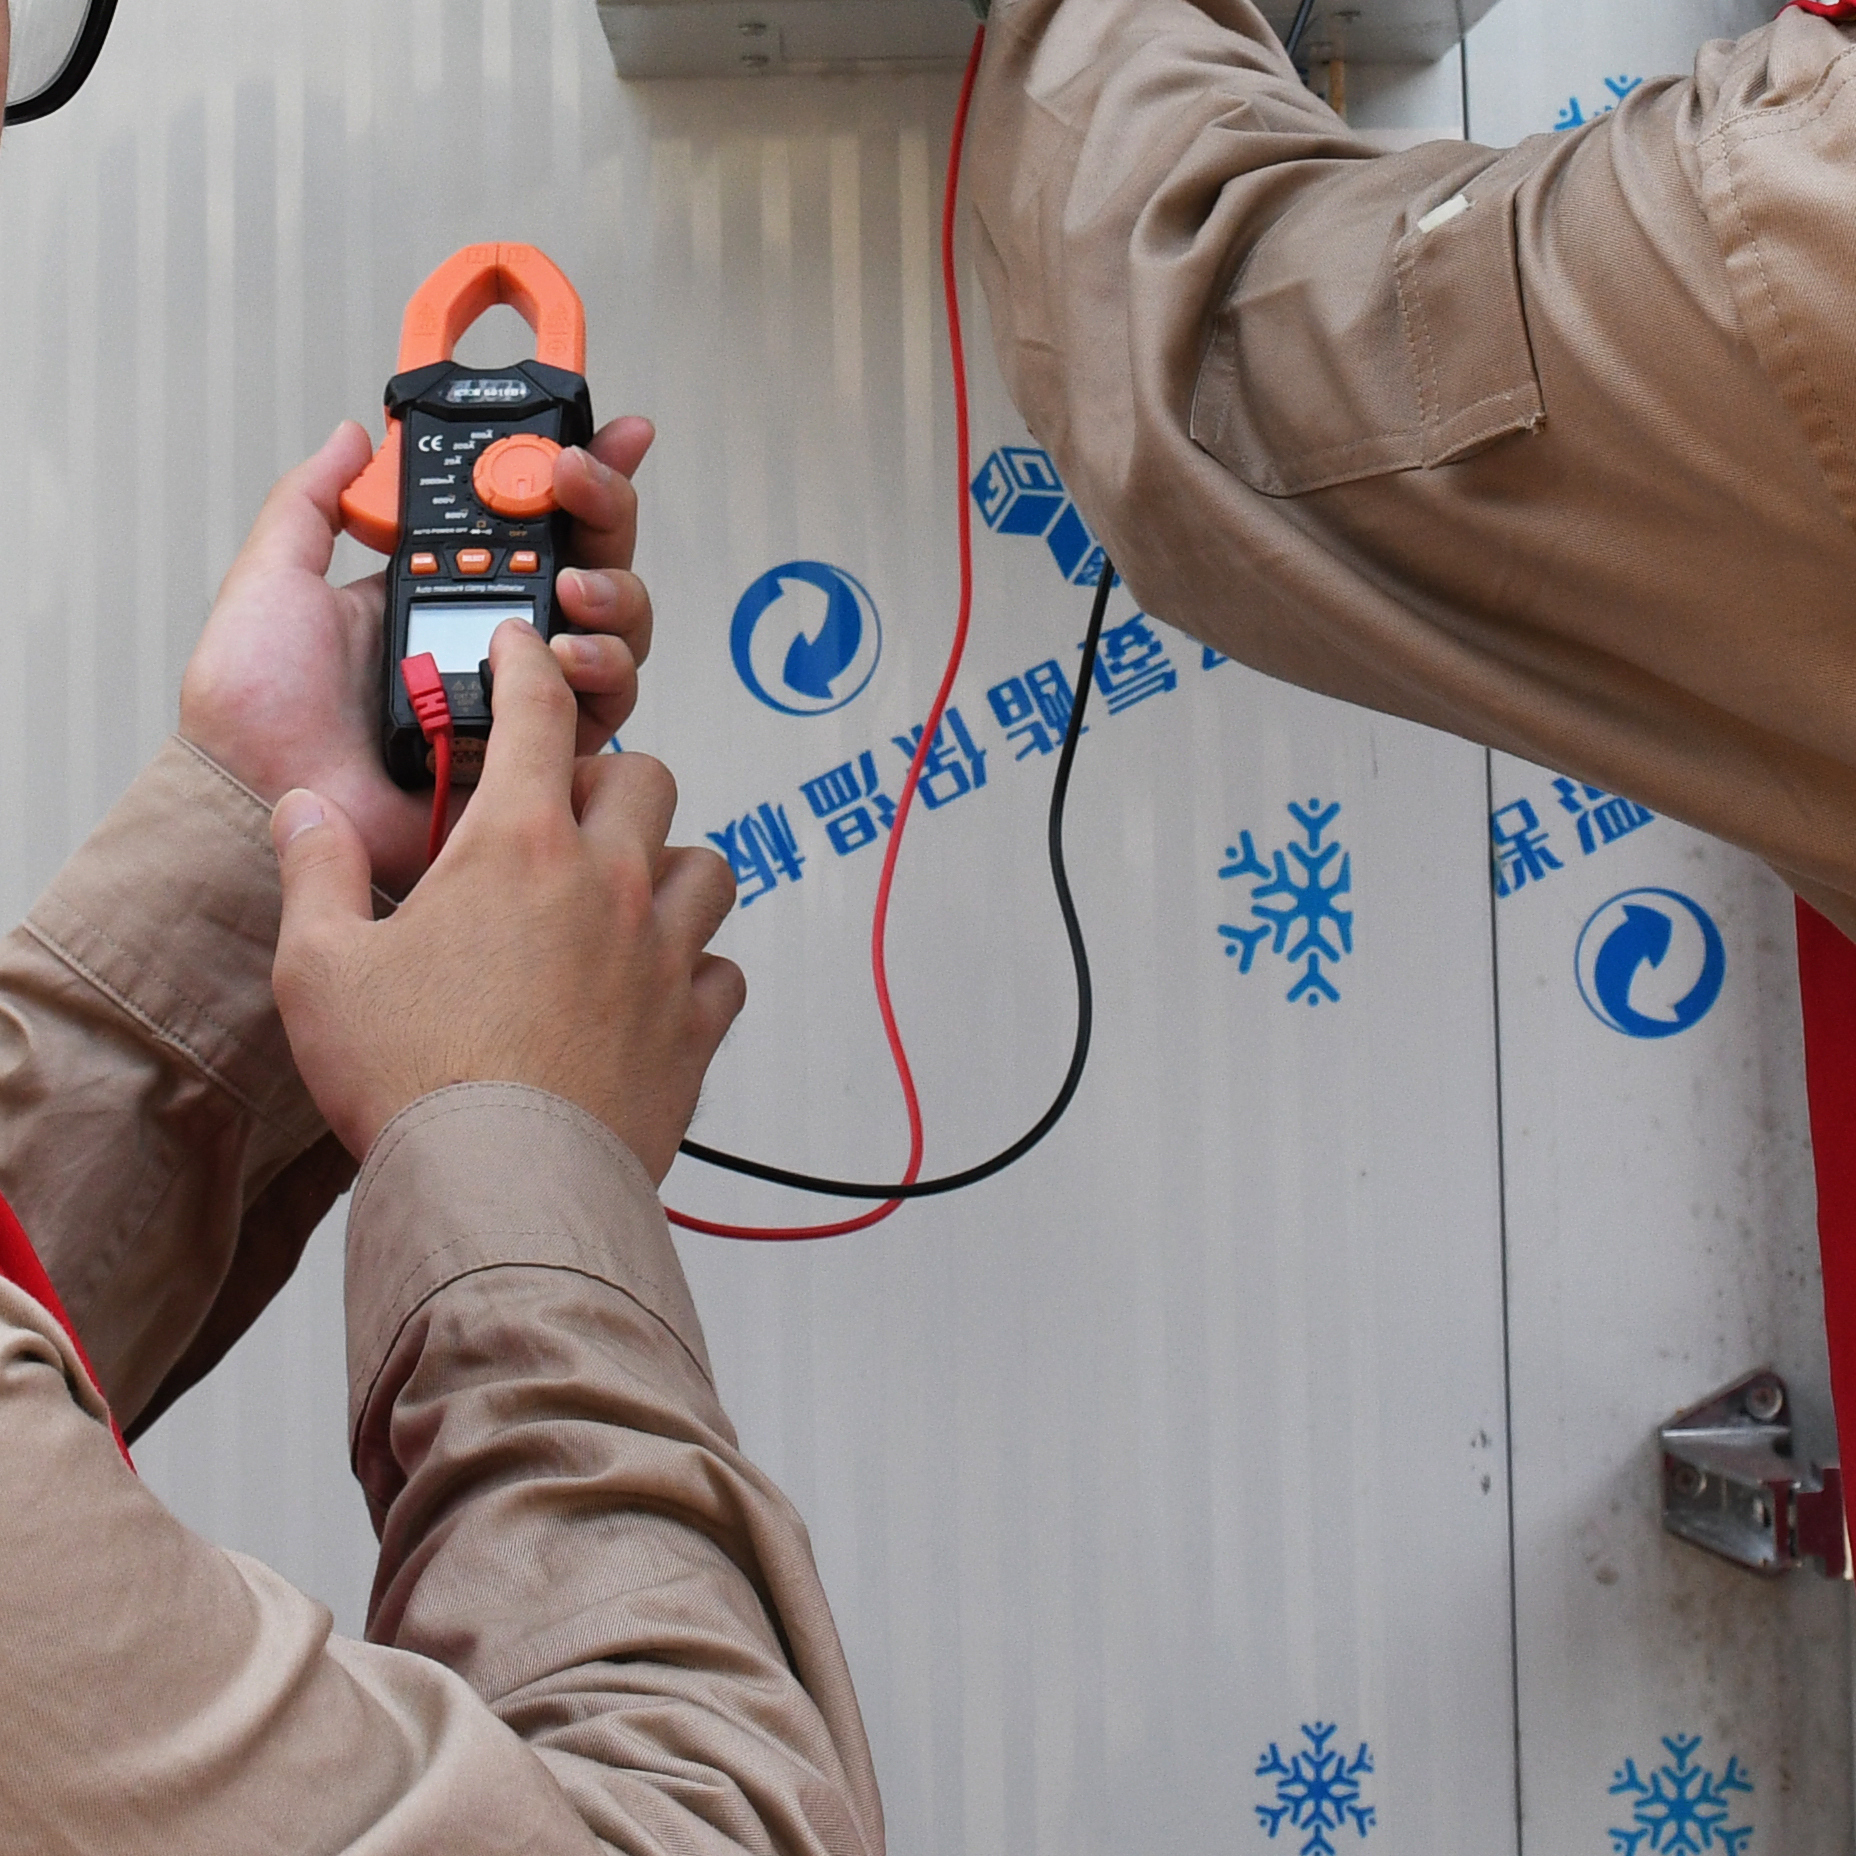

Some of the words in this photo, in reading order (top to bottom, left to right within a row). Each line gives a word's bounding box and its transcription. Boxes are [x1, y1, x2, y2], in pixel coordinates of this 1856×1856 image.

[418, 434, 444, 453] CE
[705, 611, 1229, 909] 氨酯保温板
